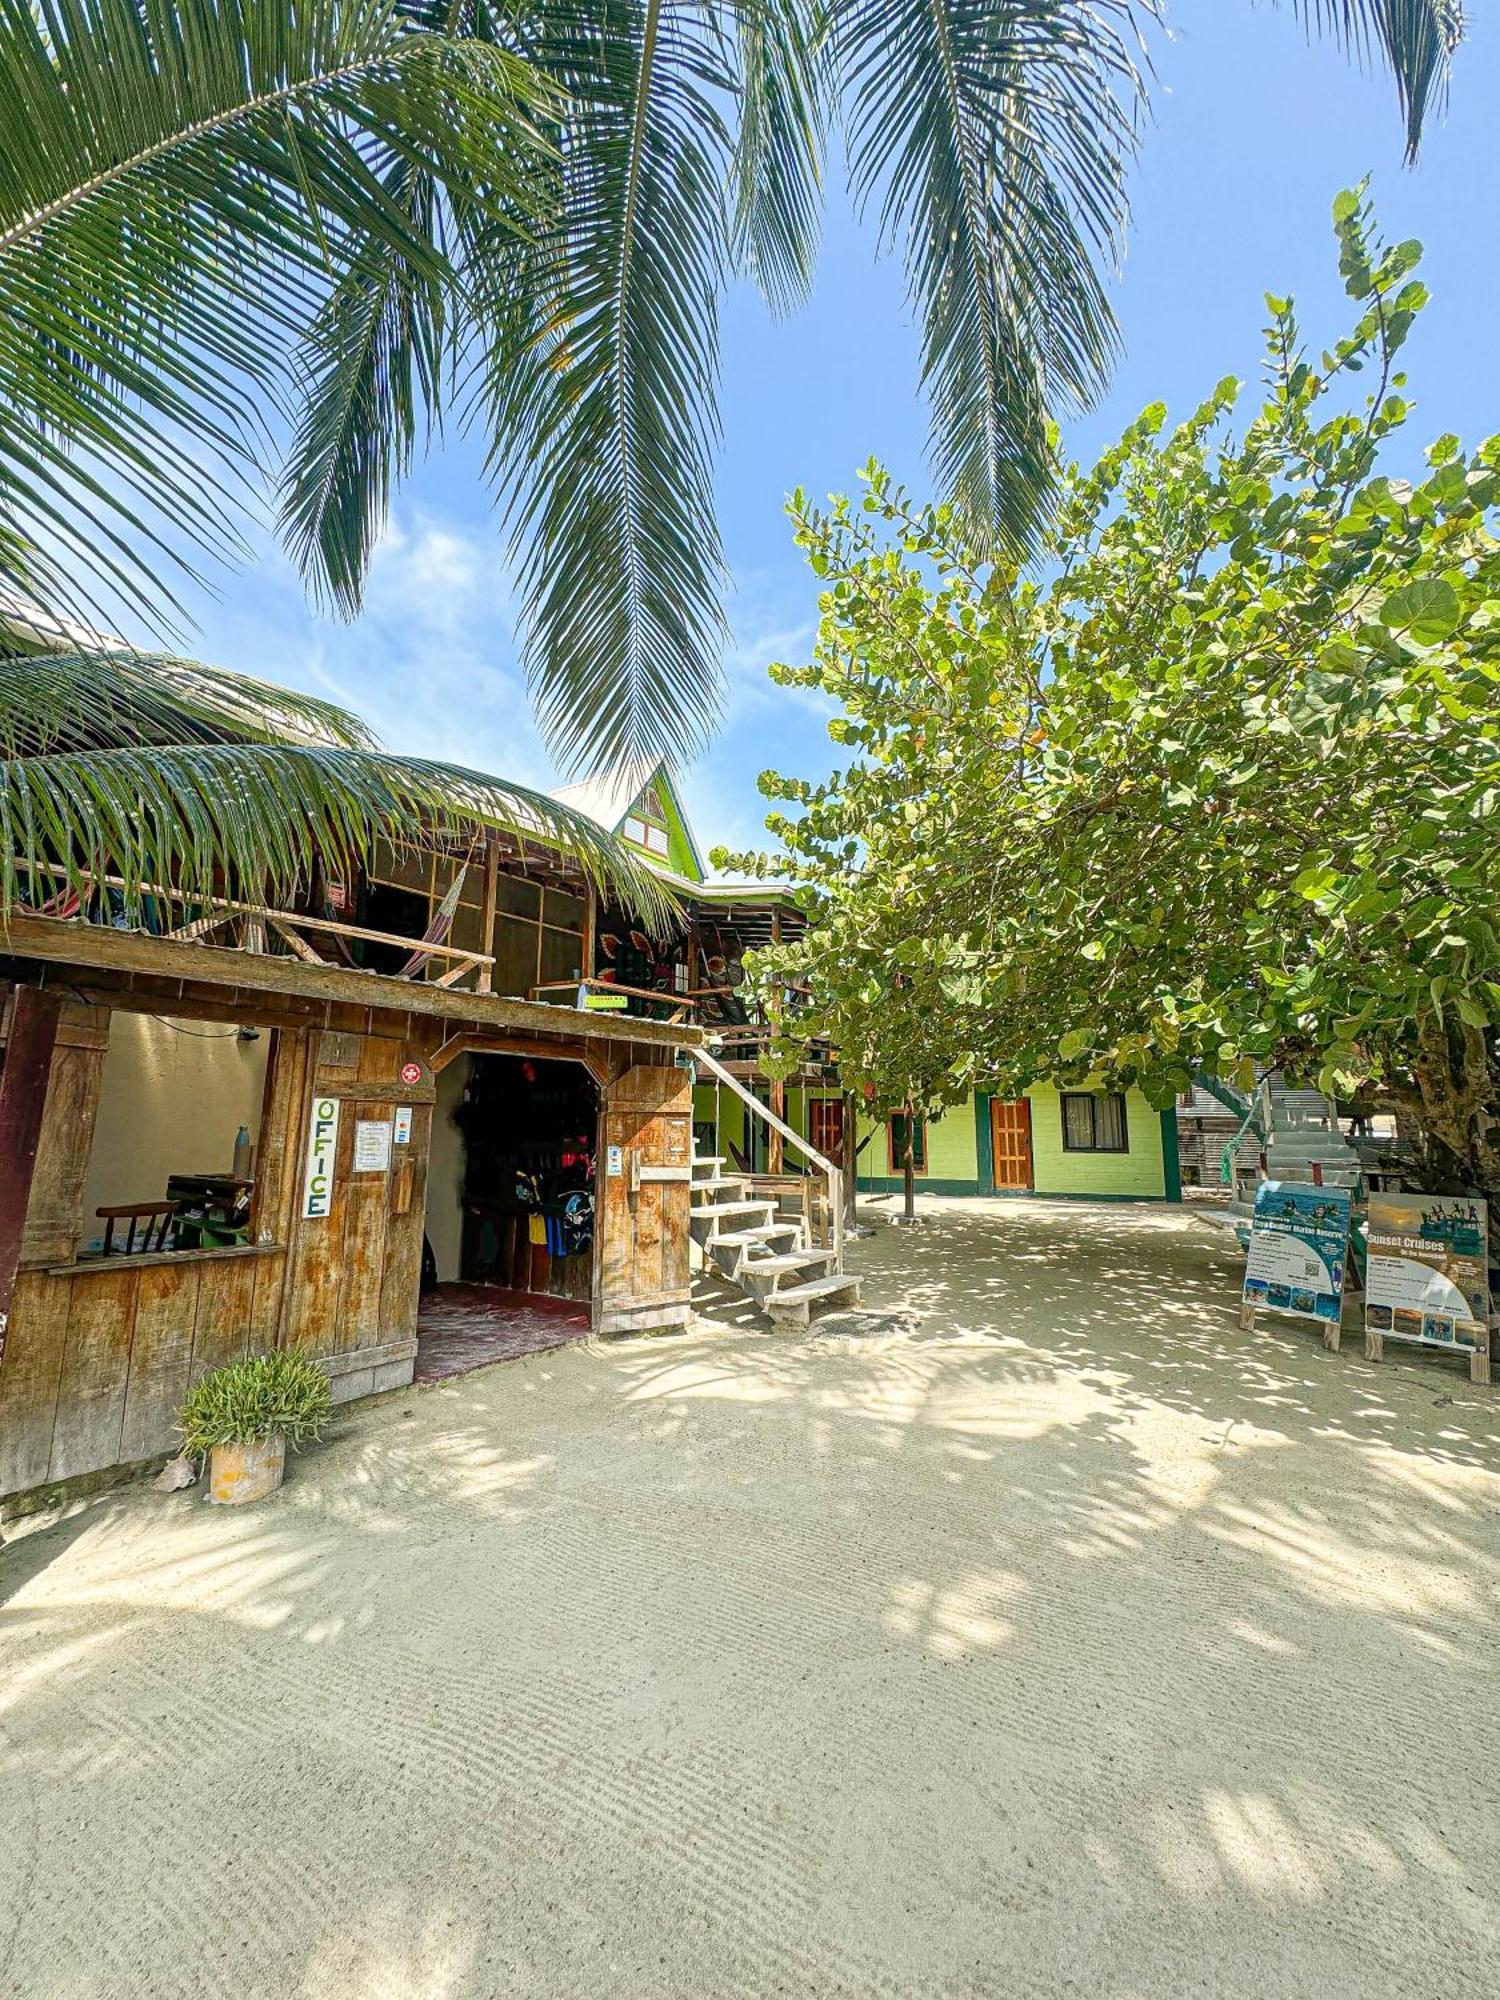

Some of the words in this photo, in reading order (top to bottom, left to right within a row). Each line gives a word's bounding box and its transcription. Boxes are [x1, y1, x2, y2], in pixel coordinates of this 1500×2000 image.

[308, 1100, 335, 1215] OFFICE
[1368, 1234, 1401, 1247] Sunset
[1404, 1238, 1445, 1251] Cruises
